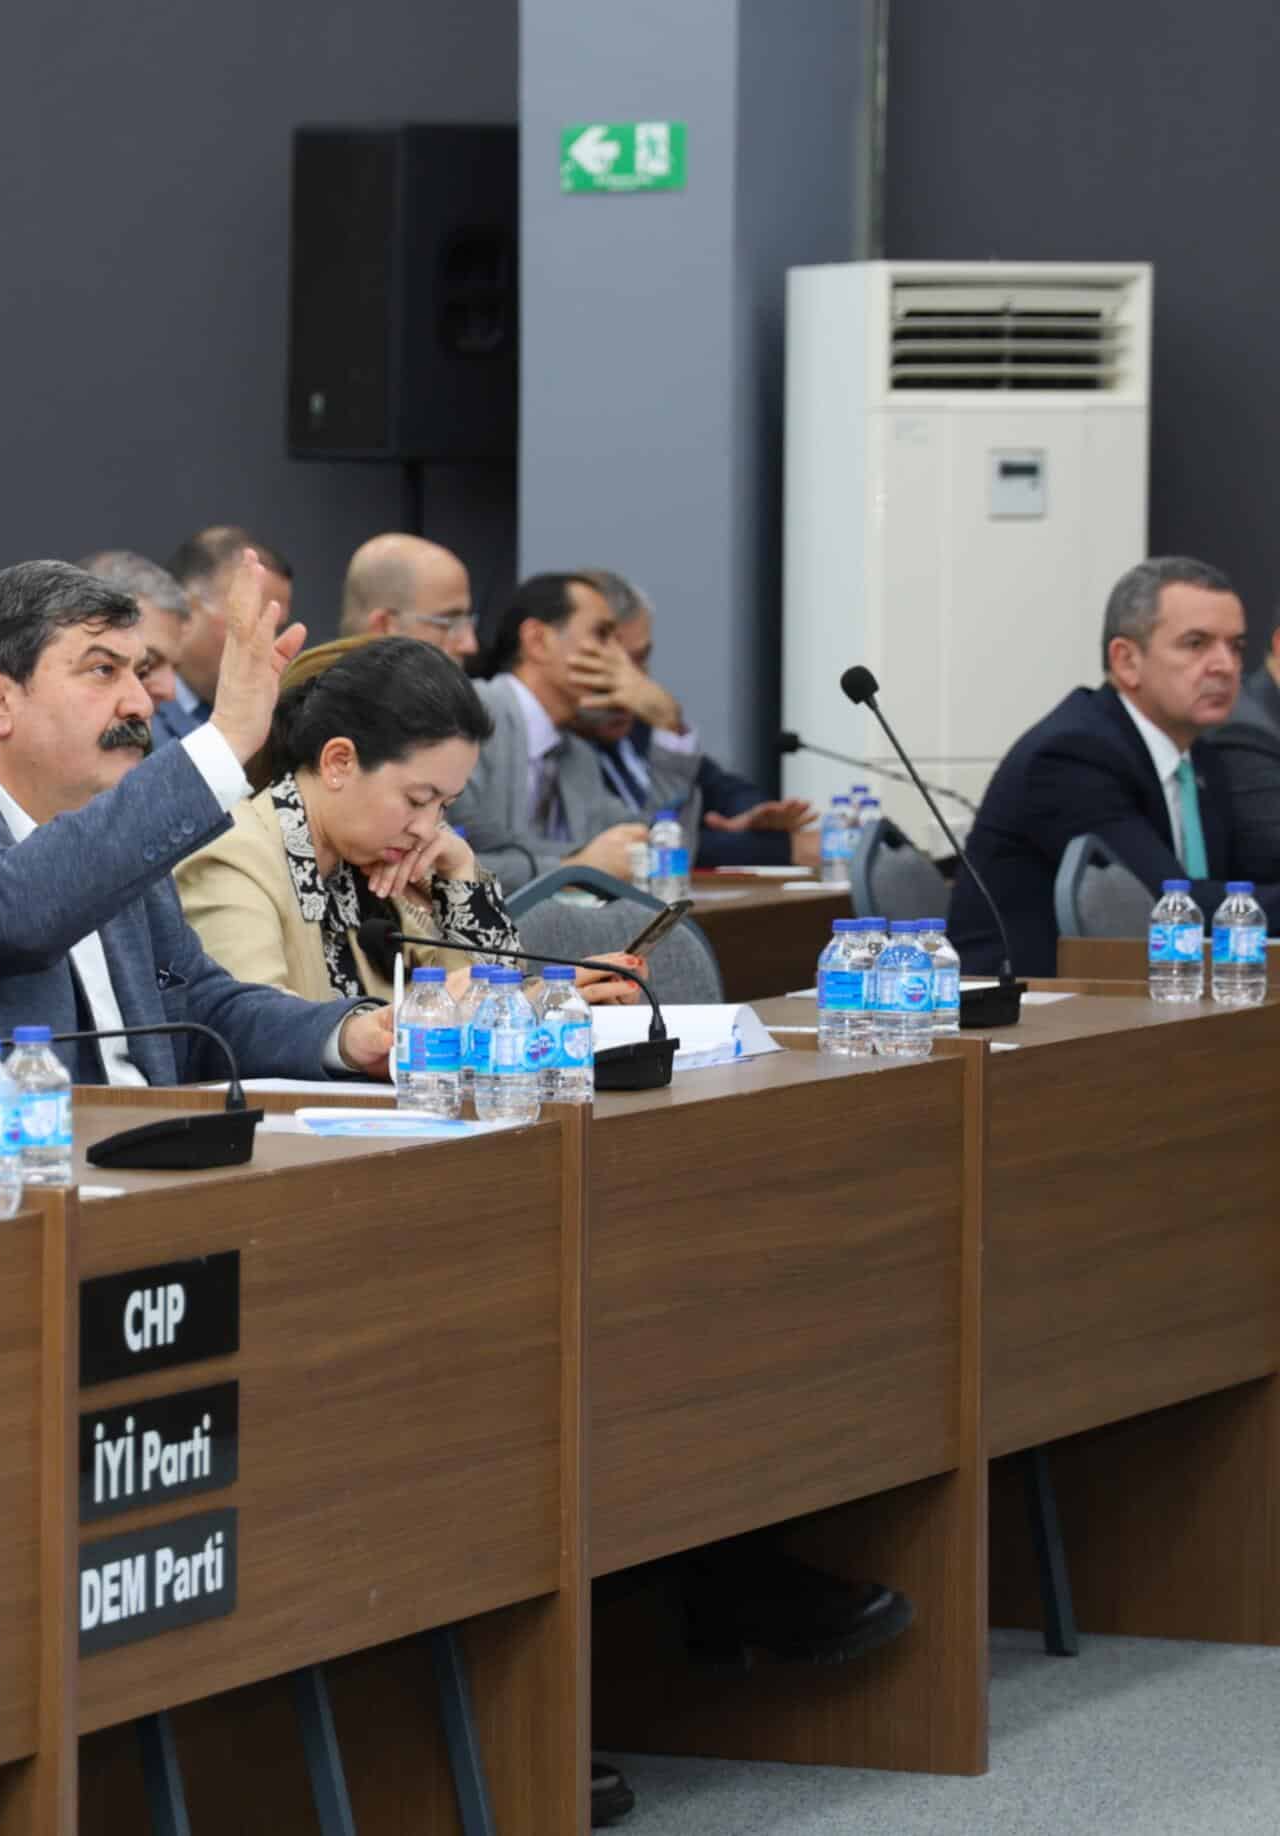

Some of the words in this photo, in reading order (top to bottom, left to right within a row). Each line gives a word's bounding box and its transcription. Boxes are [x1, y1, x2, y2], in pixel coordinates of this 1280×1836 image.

[124, 1283, 185, 1352] CHP
[94, 1416, 135, 1503] İYİ
[143, 1413, 211, 1491] Parti
[80, 1554, 147, 1631] DEM
[155, 1531, 224, 1608] Parti
